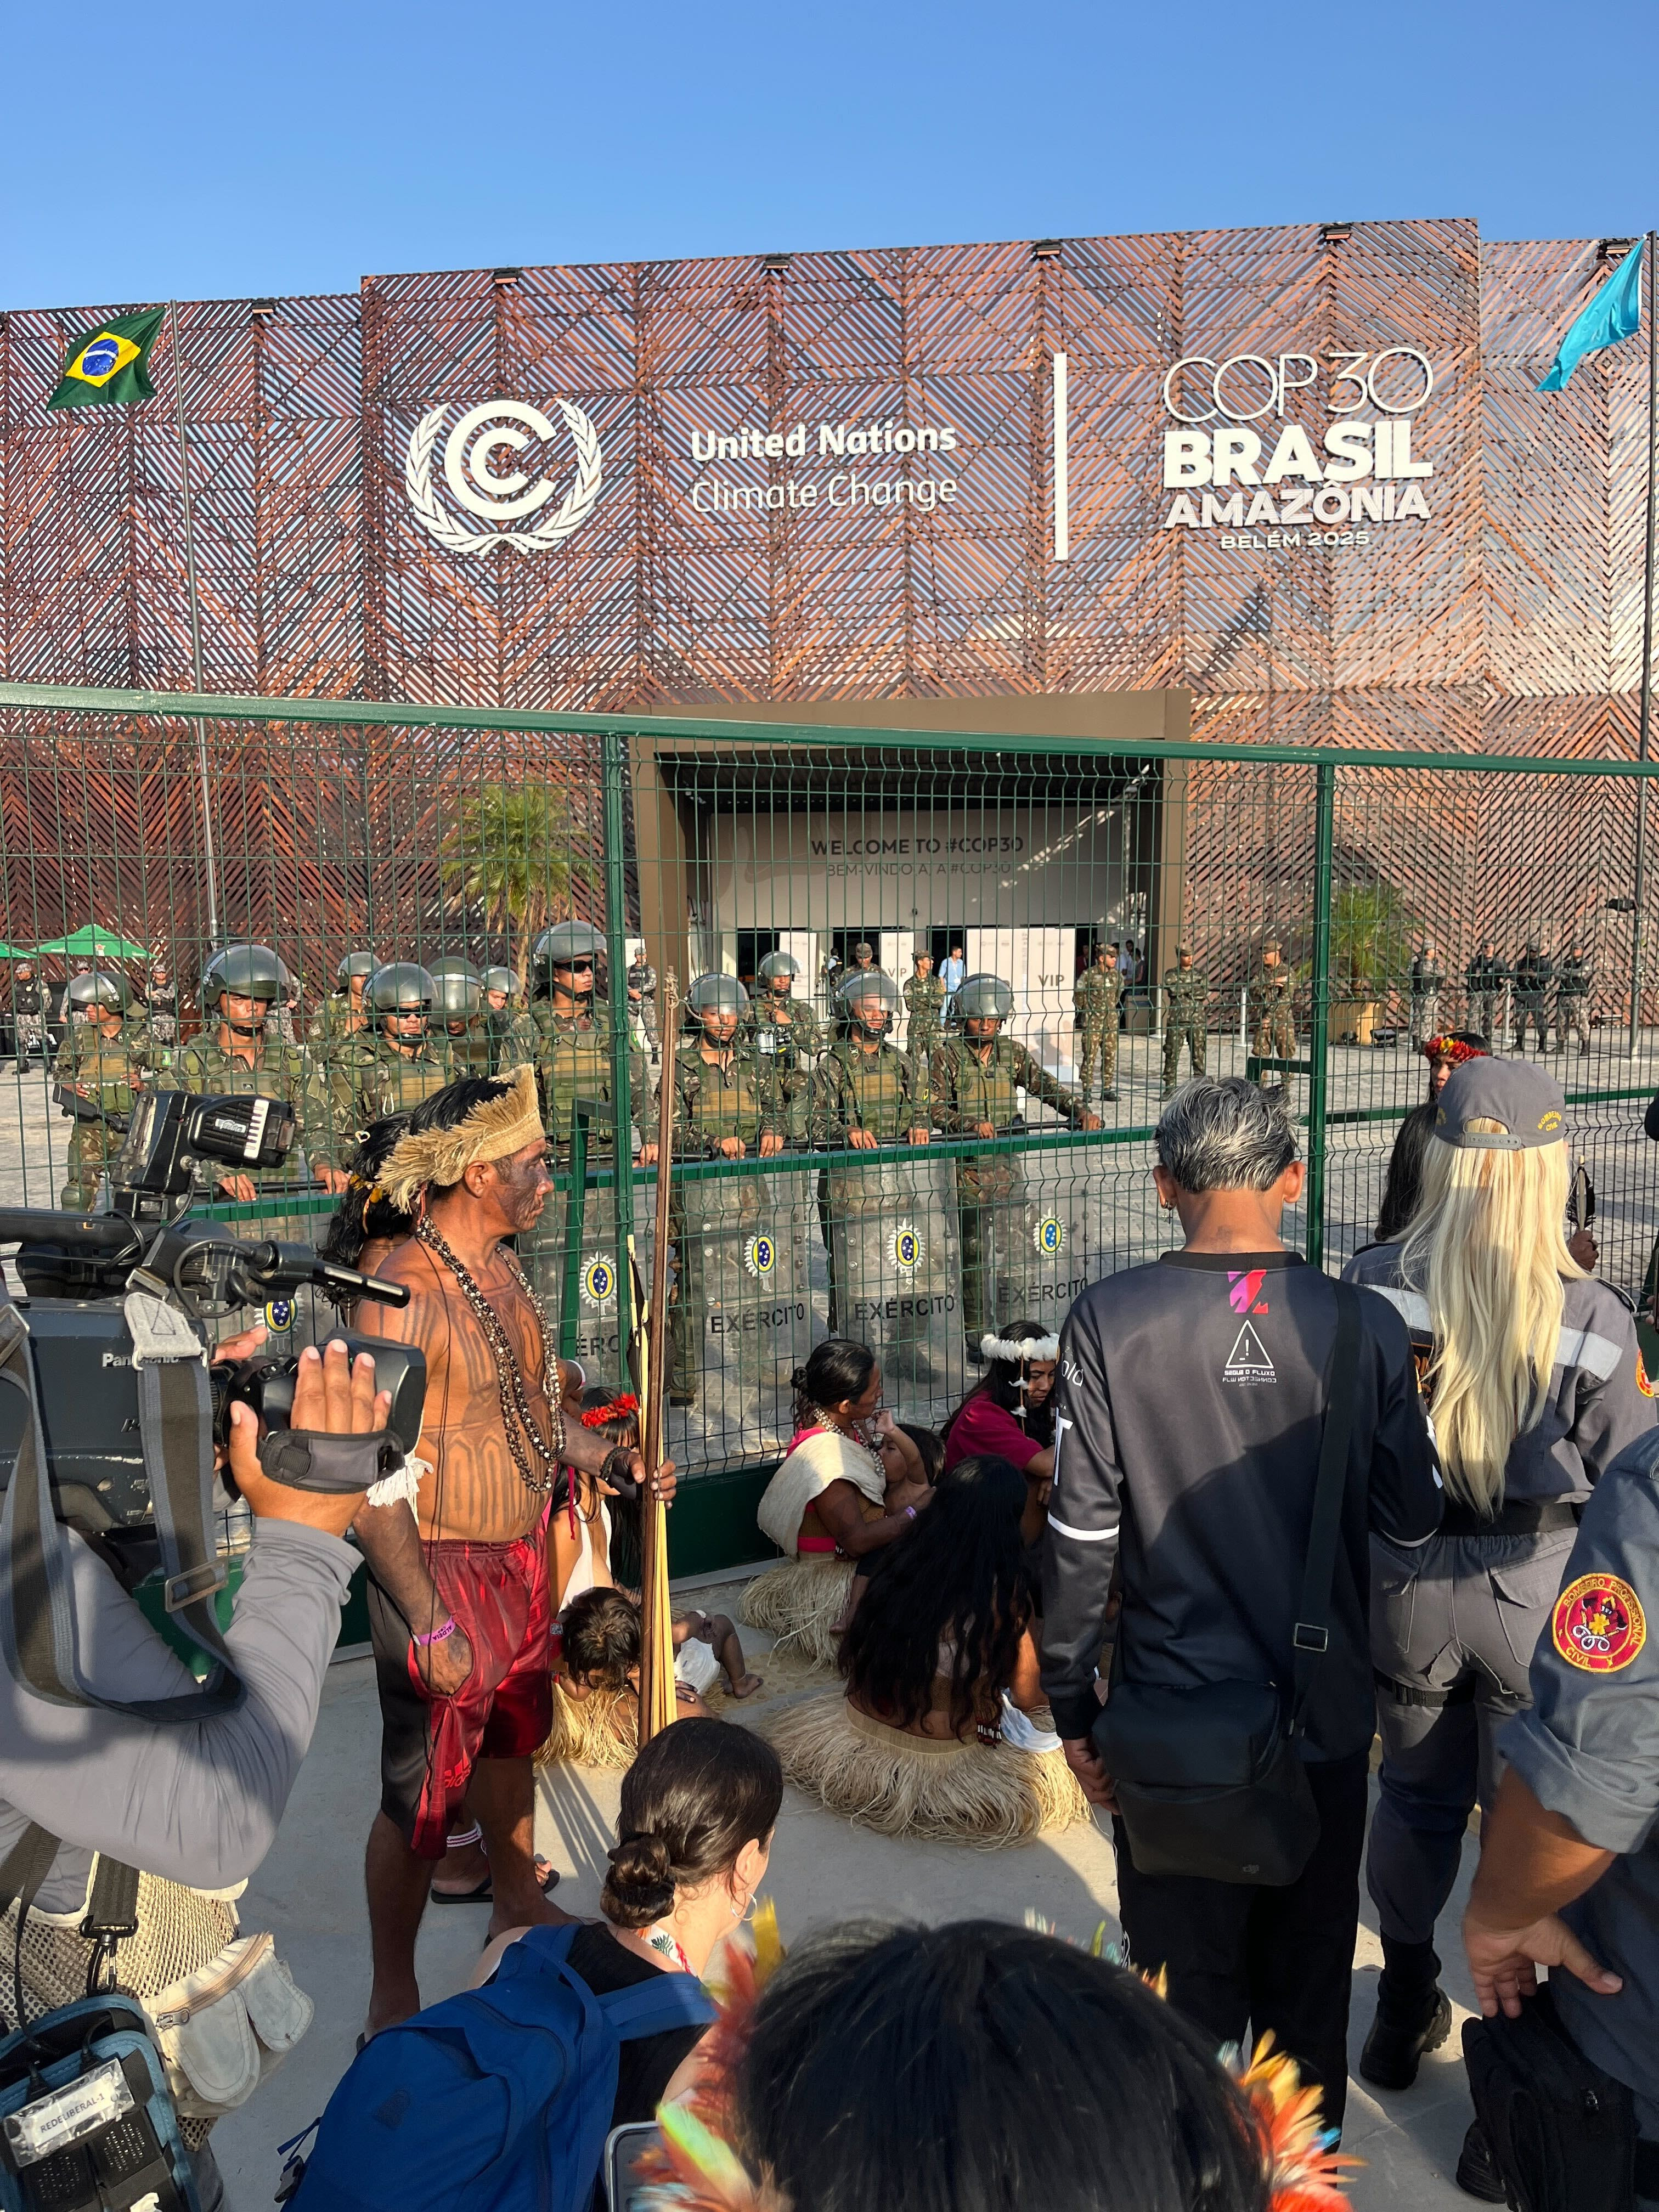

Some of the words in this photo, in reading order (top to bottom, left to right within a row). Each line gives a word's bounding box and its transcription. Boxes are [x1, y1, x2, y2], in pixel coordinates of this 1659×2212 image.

[691, 424, 806, 461] United
[819, 421, 957, 457] Nations
[1163, 420, 1434, 488] BRASIL
[692, 479, 818, 512] Climate
[828, 473, 957, 512] Change
[1164, 480, 1432, 528] AMAZÔNIA
[1221, 531, 1303, 550] BELÉM
[1308, 531, 1370, 546] 2025
[811, 839, 910, 856] WELCOME
[916, 838, 940, 854] TO
[946, 836, 1024, 853] #COP30
[888, 968, 907, 978] VP
[1038, 974, 1065, 987] VIP
[997, 1277, 1088, 1304] EXÉRCITO
[711, 1302, 804, 1334] EXÉRCITO
[854, 1294, 955, 1321] EXÉRCITO
[1565, 1646, 1591, 1667] CIVIL
